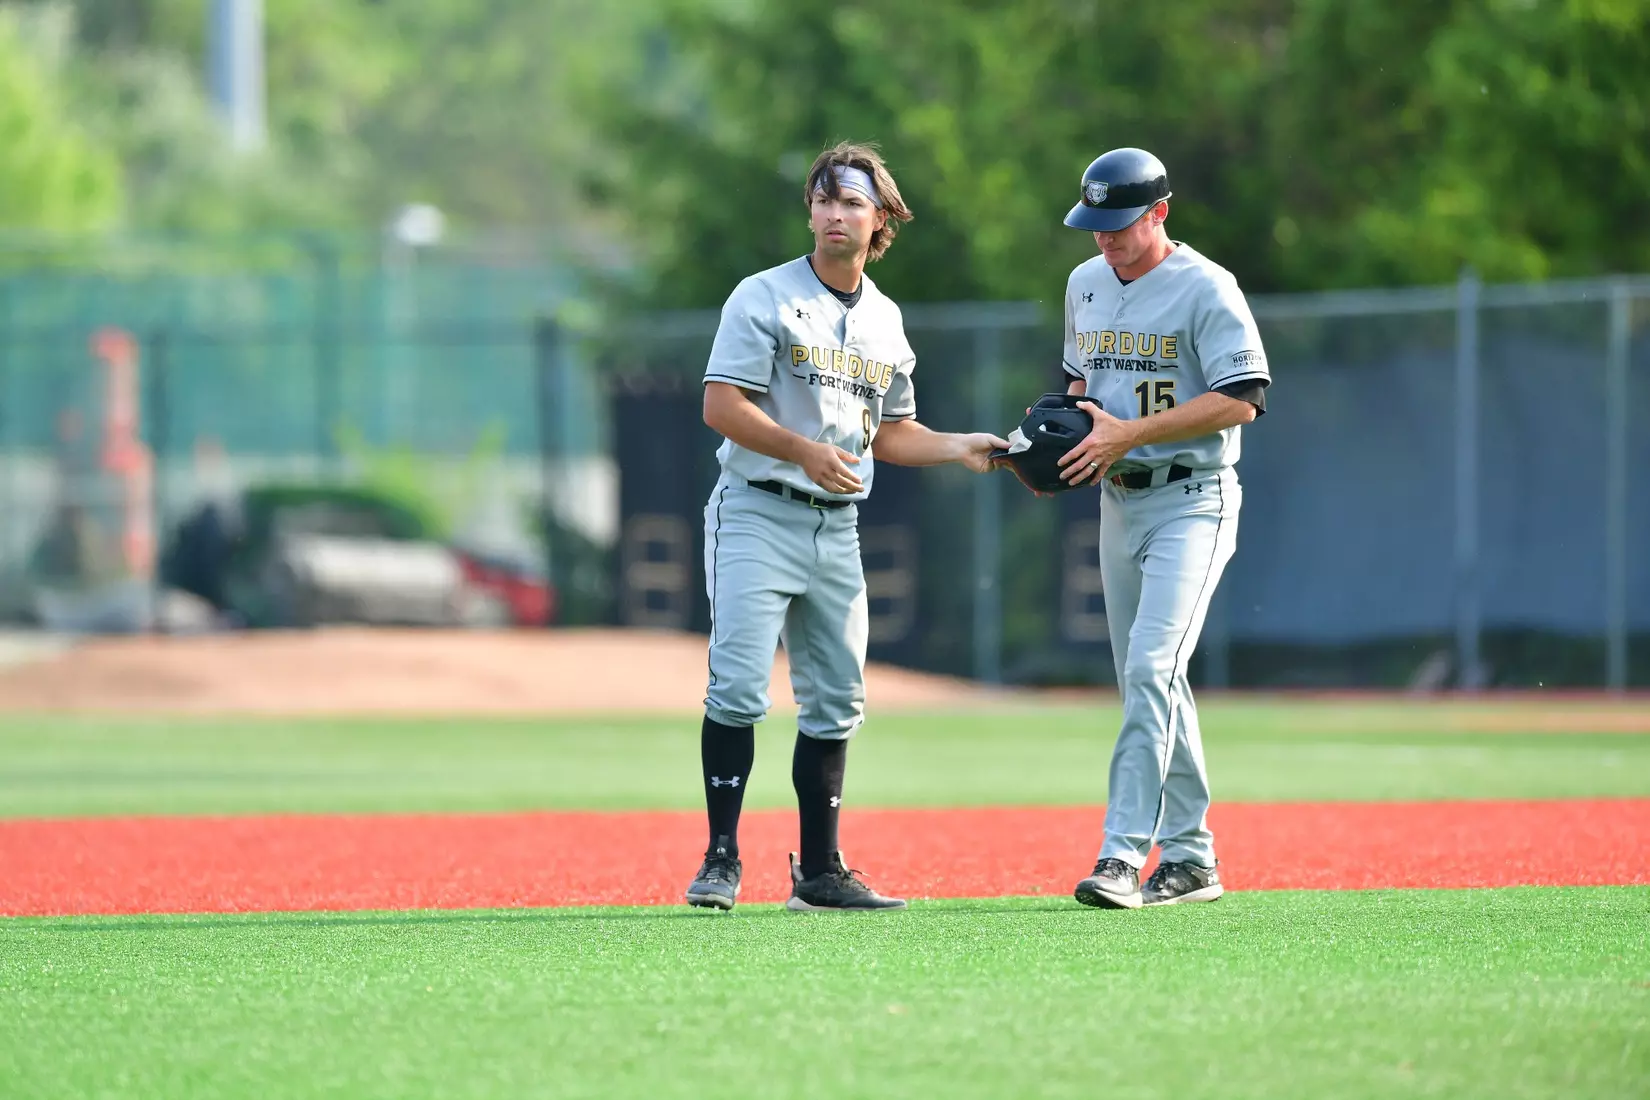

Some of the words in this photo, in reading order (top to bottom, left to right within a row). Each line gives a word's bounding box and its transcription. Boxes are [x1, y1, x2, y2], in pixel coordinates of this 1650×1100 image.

[1076, 331, 1178, 358] PURDUE
[791, 345, 893, 389] PURDUE
[1114, 359, 1158, 372] WAYNE
[1135, 378, 1177, 418] 15
[862, 408, 871, 450] 9
